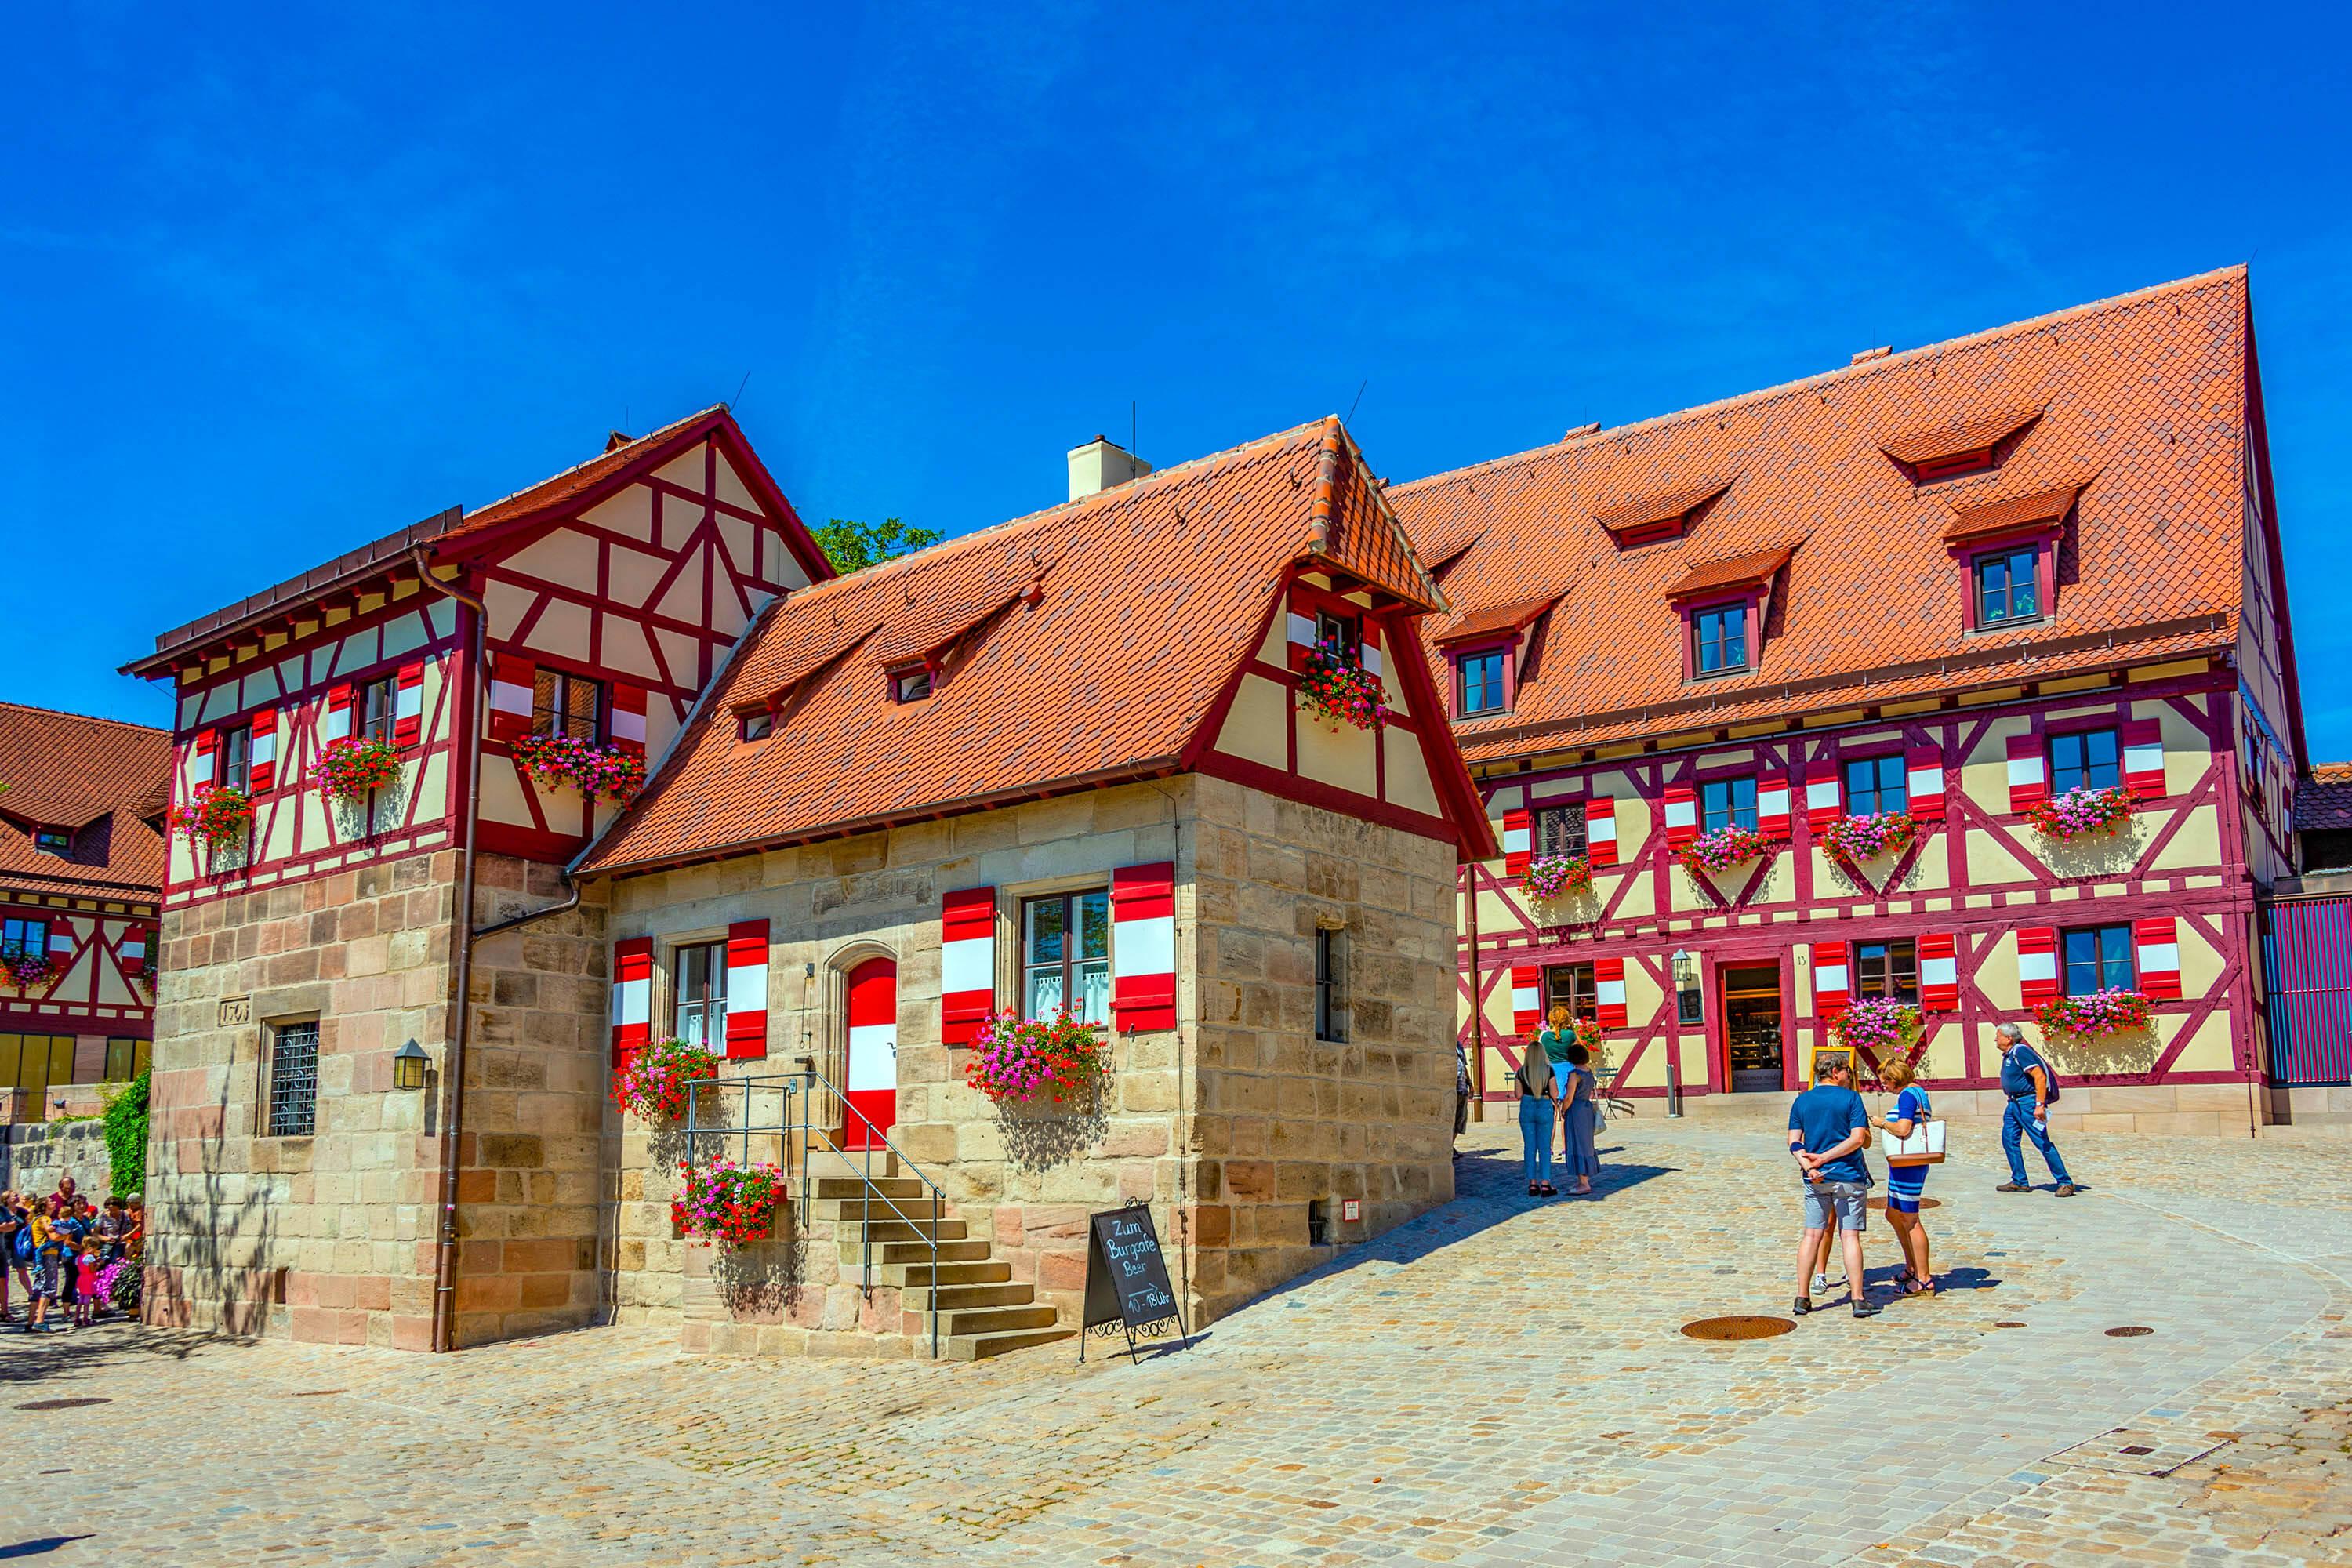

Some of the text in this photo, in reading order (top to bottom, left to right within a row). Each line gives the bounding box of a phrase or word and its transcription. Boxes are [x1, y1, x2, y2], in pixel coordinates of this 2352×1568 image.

[1798, 956, 1806, 965] 13
[1112, 1220, 1142, 1236] Zum
[1123, 1261, 1146, 1277] Beer
